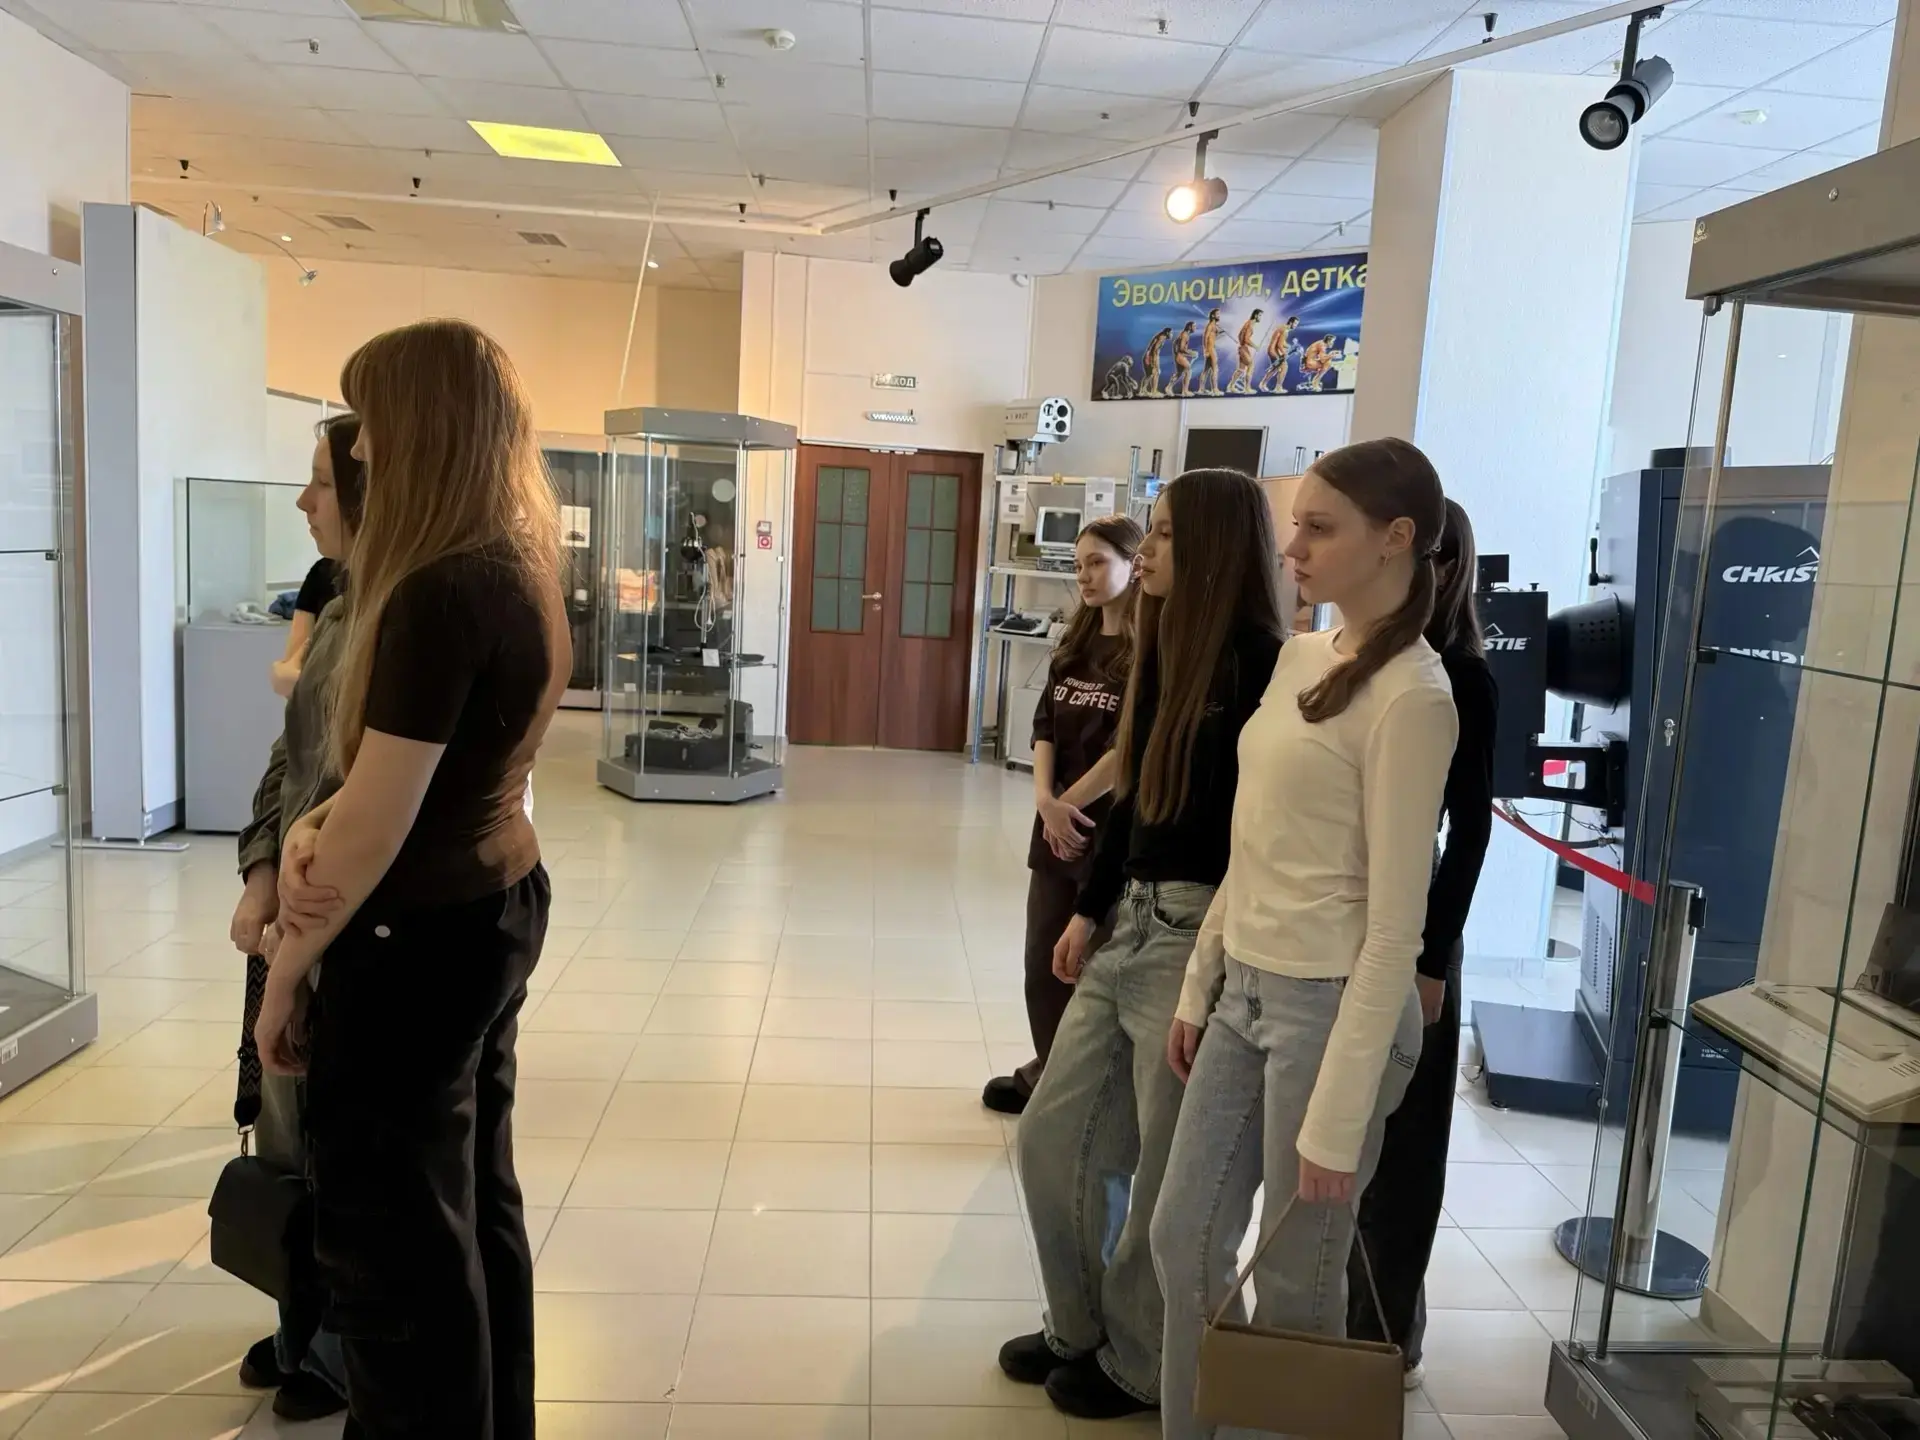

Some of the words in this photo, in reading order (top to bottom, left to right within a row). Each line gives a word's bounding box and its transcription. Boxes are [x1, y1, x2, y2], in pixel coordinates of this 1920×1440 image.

[1112, 272, 1272, 308] Эволюция,
[1063, 677, 1096, 691] POWERED
[1068, 690, 1120, 712] COFFEE
